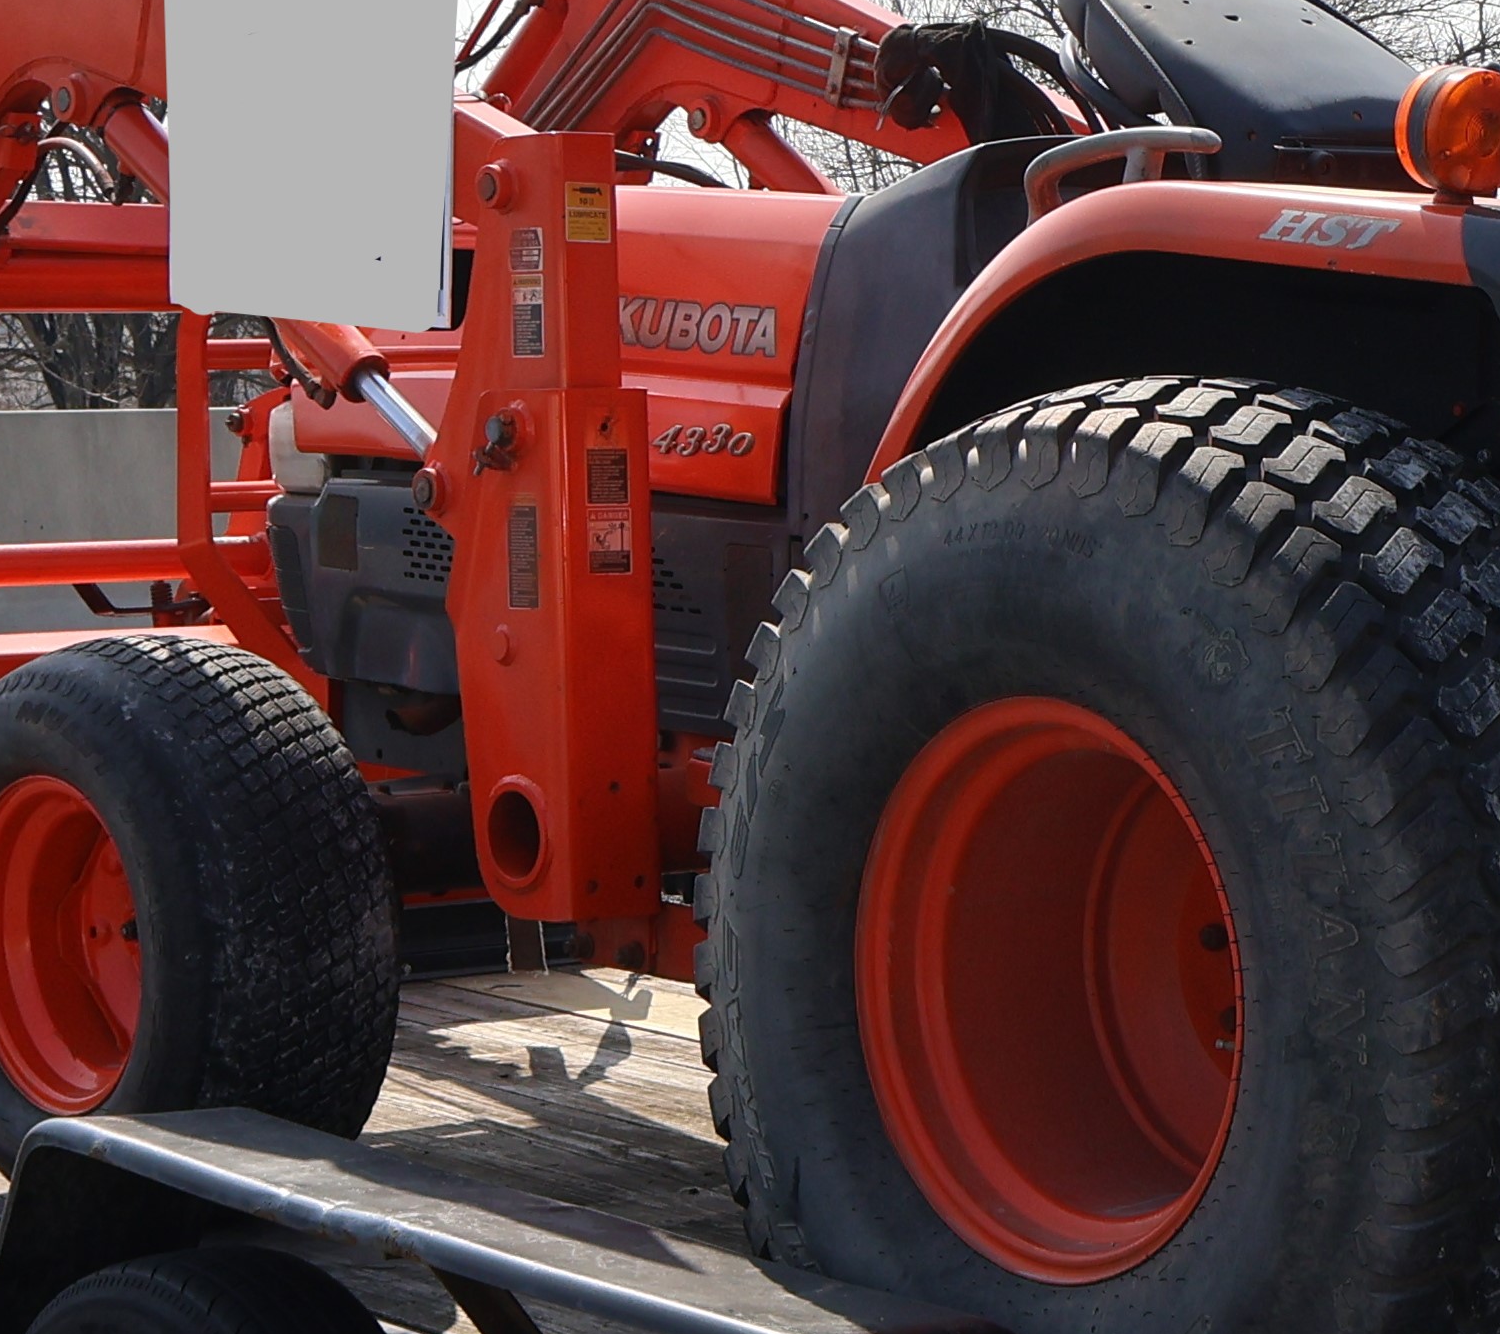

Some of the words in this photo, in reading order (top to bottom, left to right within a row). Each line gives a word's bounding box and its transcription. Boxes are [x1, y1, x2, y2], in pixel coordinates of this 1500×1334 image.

[568, 210, 607, 220] LUBRICATE
[1258, 208, 1403, 250] HST
[619, 295, 777, 358] KUBOTA
[652, 422, 756, 457] 4330
[597, 511, 629, 520] DANGER
[1246, 702, 1368, 1068] TITAN
